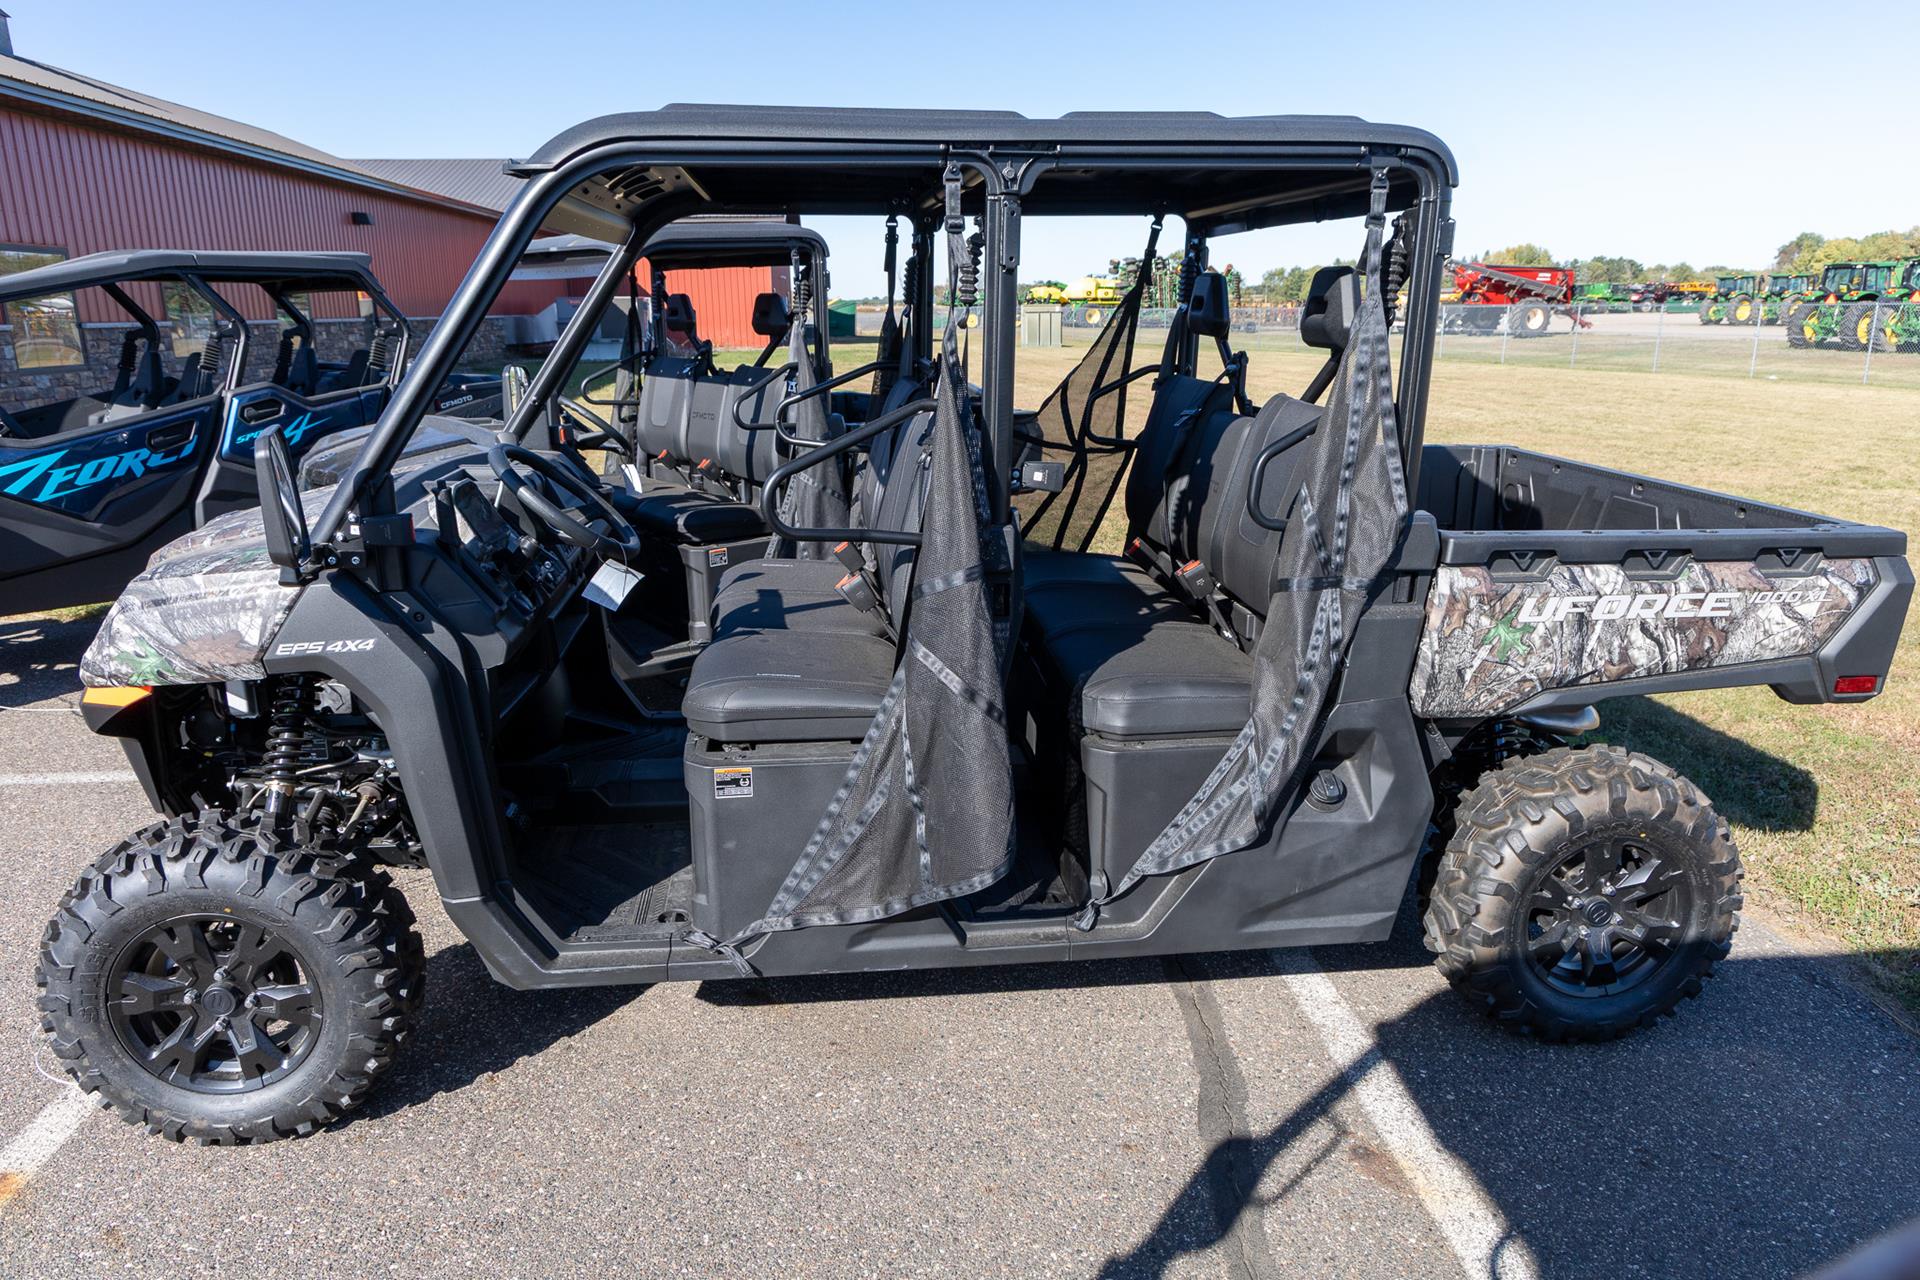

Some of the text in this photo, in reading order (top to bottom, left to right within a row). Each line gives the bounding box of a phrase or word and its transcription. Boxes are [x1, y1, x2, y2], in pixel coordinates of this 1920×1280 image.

[440, 394, 474, 409] CFMOTO
[283, 412, 333, 446] 4
[1518, 591, 1832, 622] UFORCE 1000 XL
[275, 638, 377, 656] EPS 4X4
